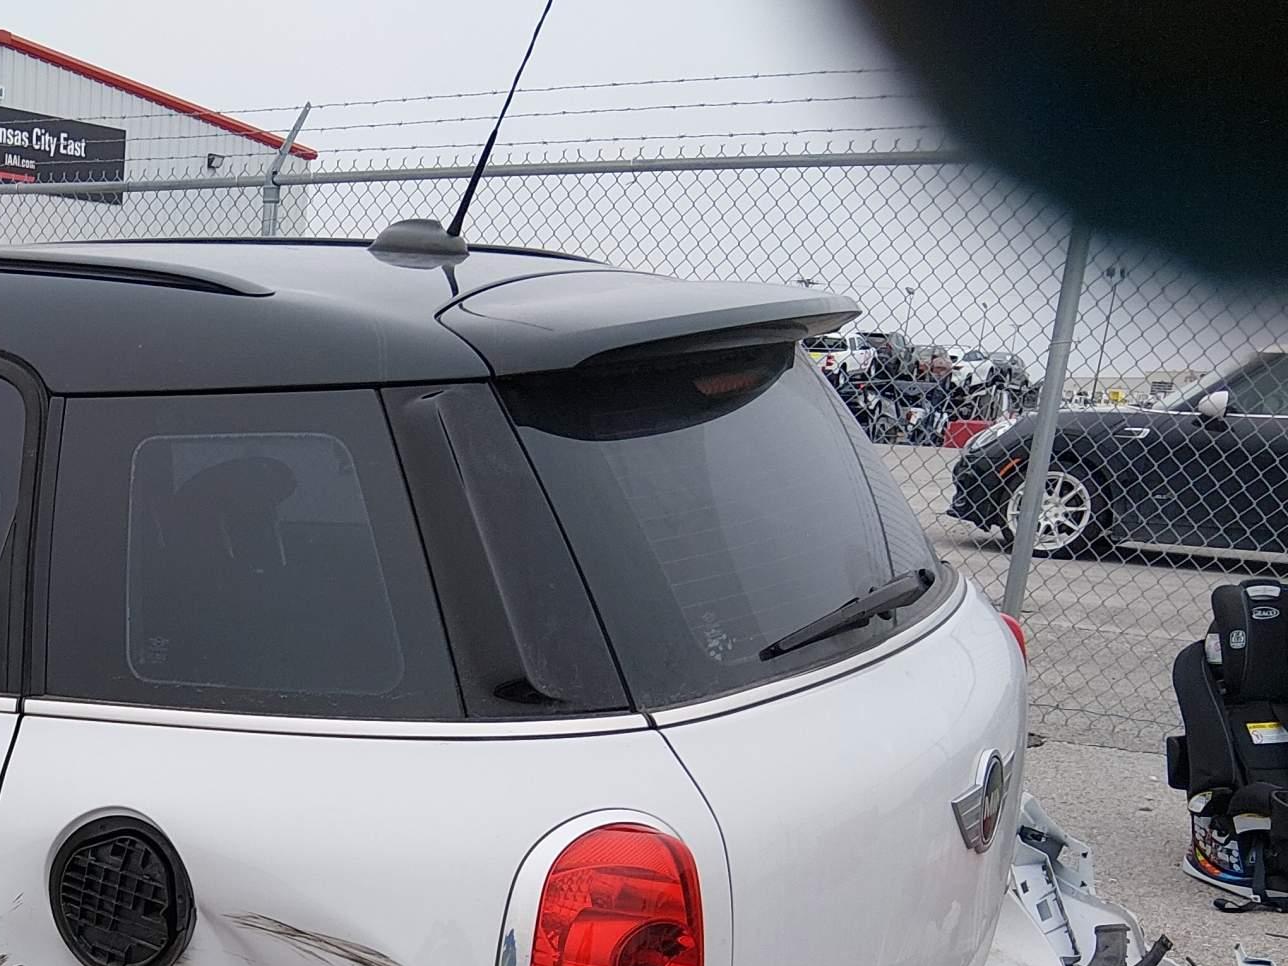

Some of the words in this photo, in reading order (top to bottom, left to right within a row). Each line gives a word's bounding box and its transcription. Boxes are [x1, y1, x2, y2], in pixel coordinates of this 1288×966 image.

[32, 127, 57, 157] City
[59, 132, 86, 158] East
[4, 152, 36, 170] IAAI.com
